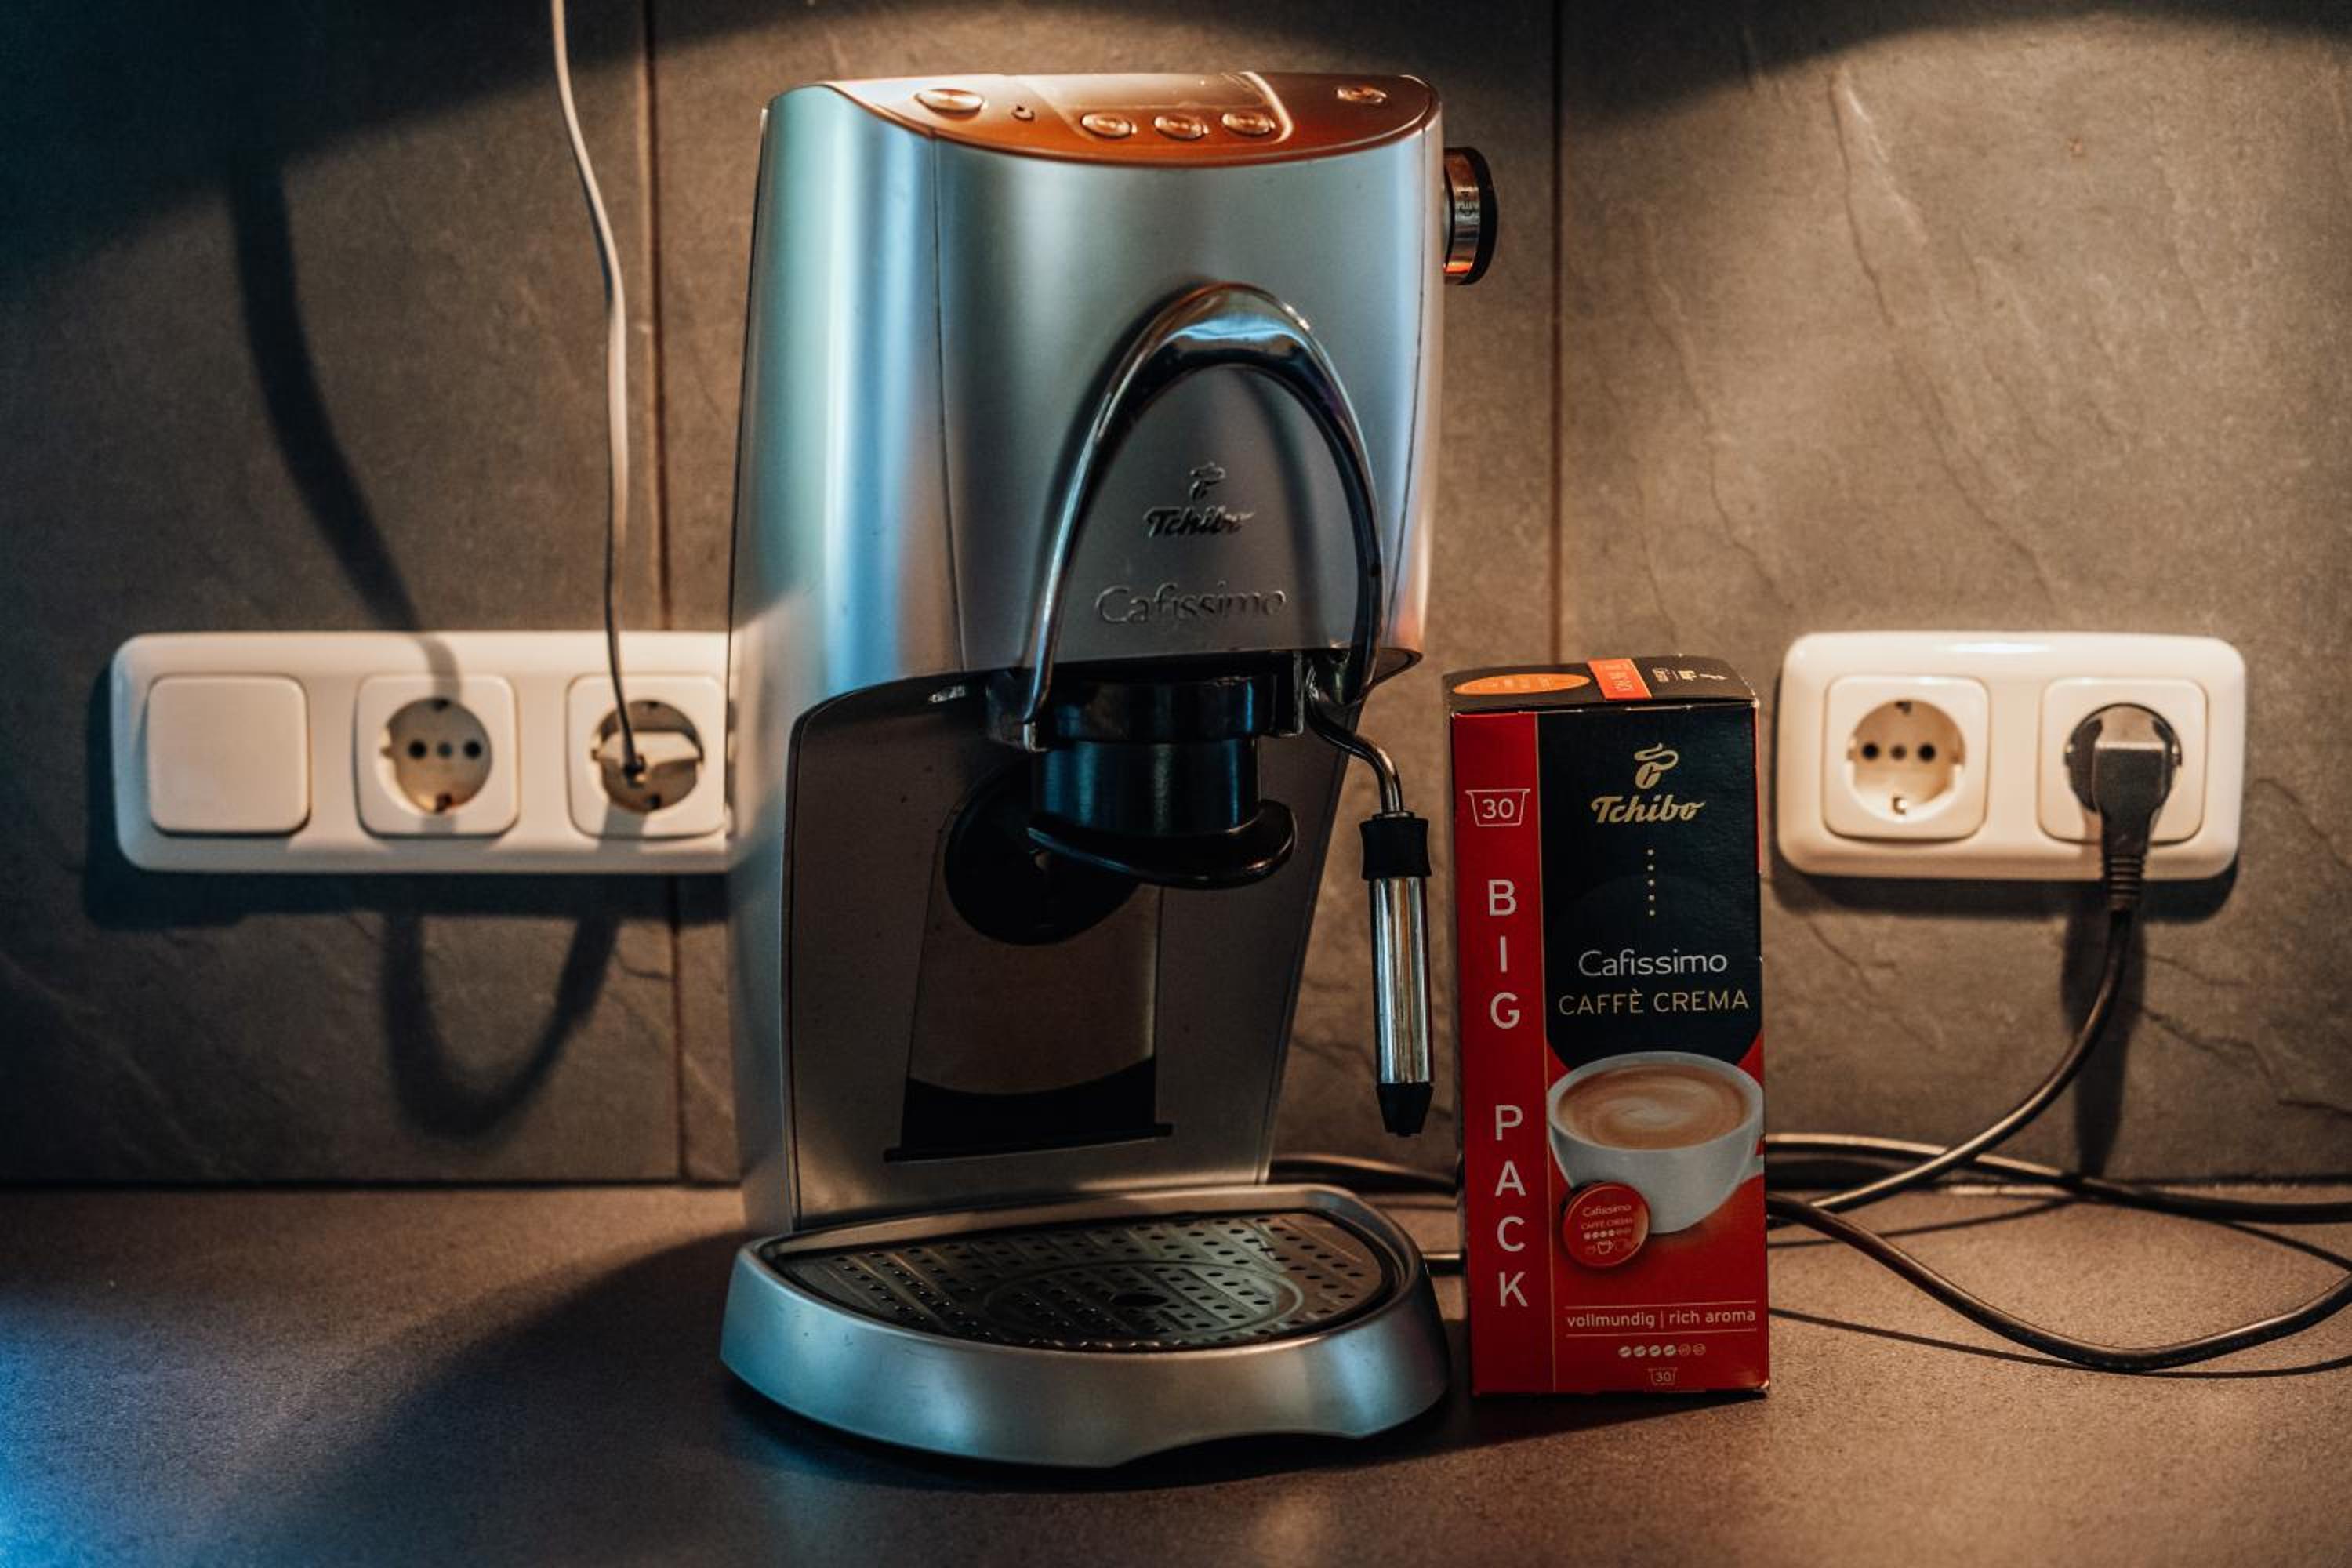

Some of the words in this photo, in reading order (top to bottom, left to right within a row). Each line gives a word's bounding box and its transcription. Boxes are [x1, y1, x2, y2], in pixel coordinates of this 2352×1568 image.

[1096, 580, 1287, 622] Cafissimo
[1481, 797, 1515, 821] 30
[1590, 793, 1706, 824] Tchibo
[1488, 878, 1521, 1029] BIG
[1578, 948, 1728, 977] Cafissimo
[1558, 987, 1644, 1016] CAFFÈ
[1653, 989, 1750, 1013] CREMA
[1494, 1104, 1529, 1308] PACK
[1567, 1312, 1656, 1329] vollmundig
[1669, 1310, 1700, 1325] rich
[1705, 1310, 1756, 1323] aroma
[1655, 1371, 1672, 1383] 30
